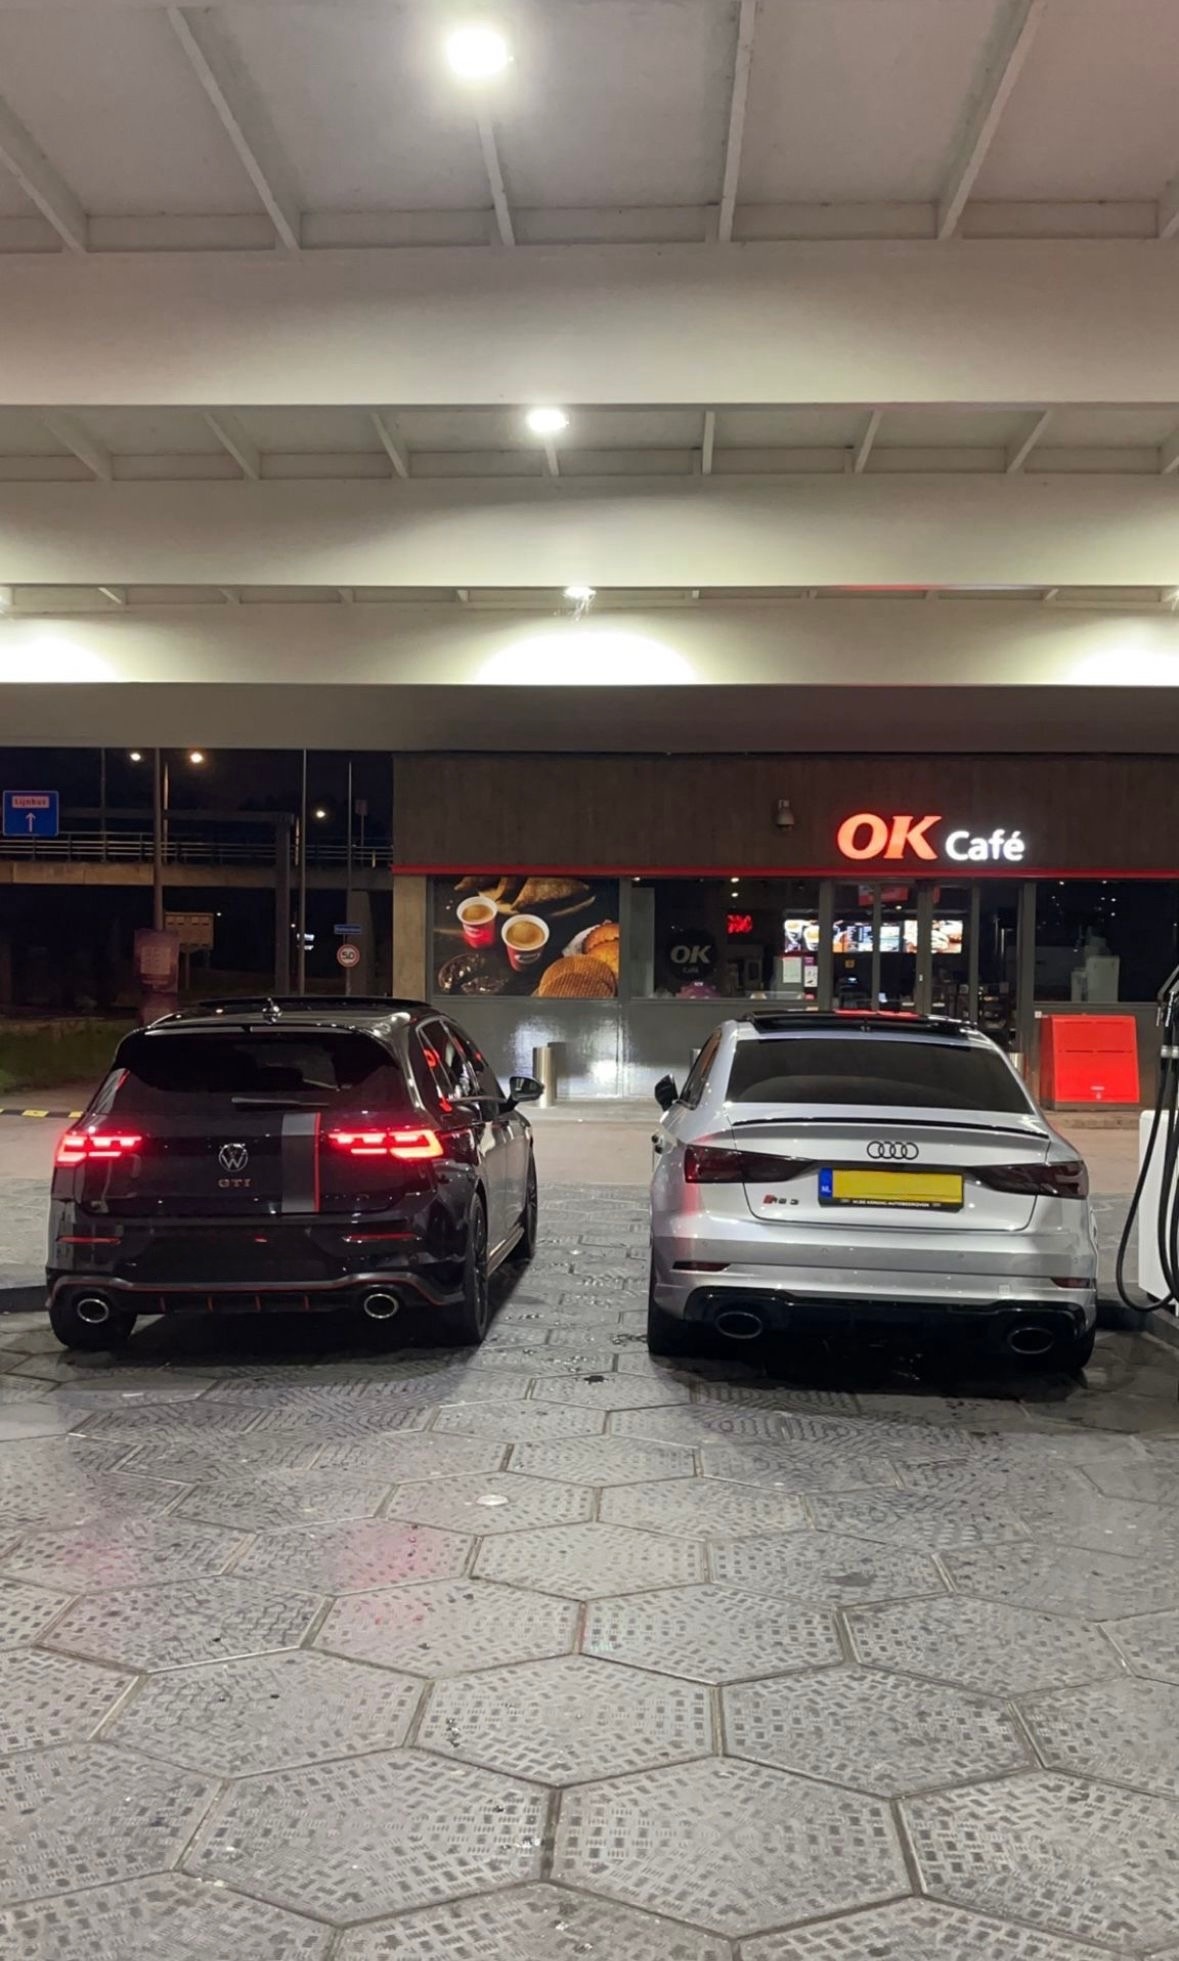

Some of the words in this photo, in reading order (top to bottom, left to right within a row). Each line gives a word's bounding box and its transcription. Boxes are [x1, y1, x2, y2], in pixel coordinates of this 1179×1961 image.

[837, 813, 942, 860] OK
[945, 828, 1025, 861] Café
[341, 951, 355, 960] 50
[670, 945, 711, 964] OK
[218, 1178, 251, 1188] GTI
